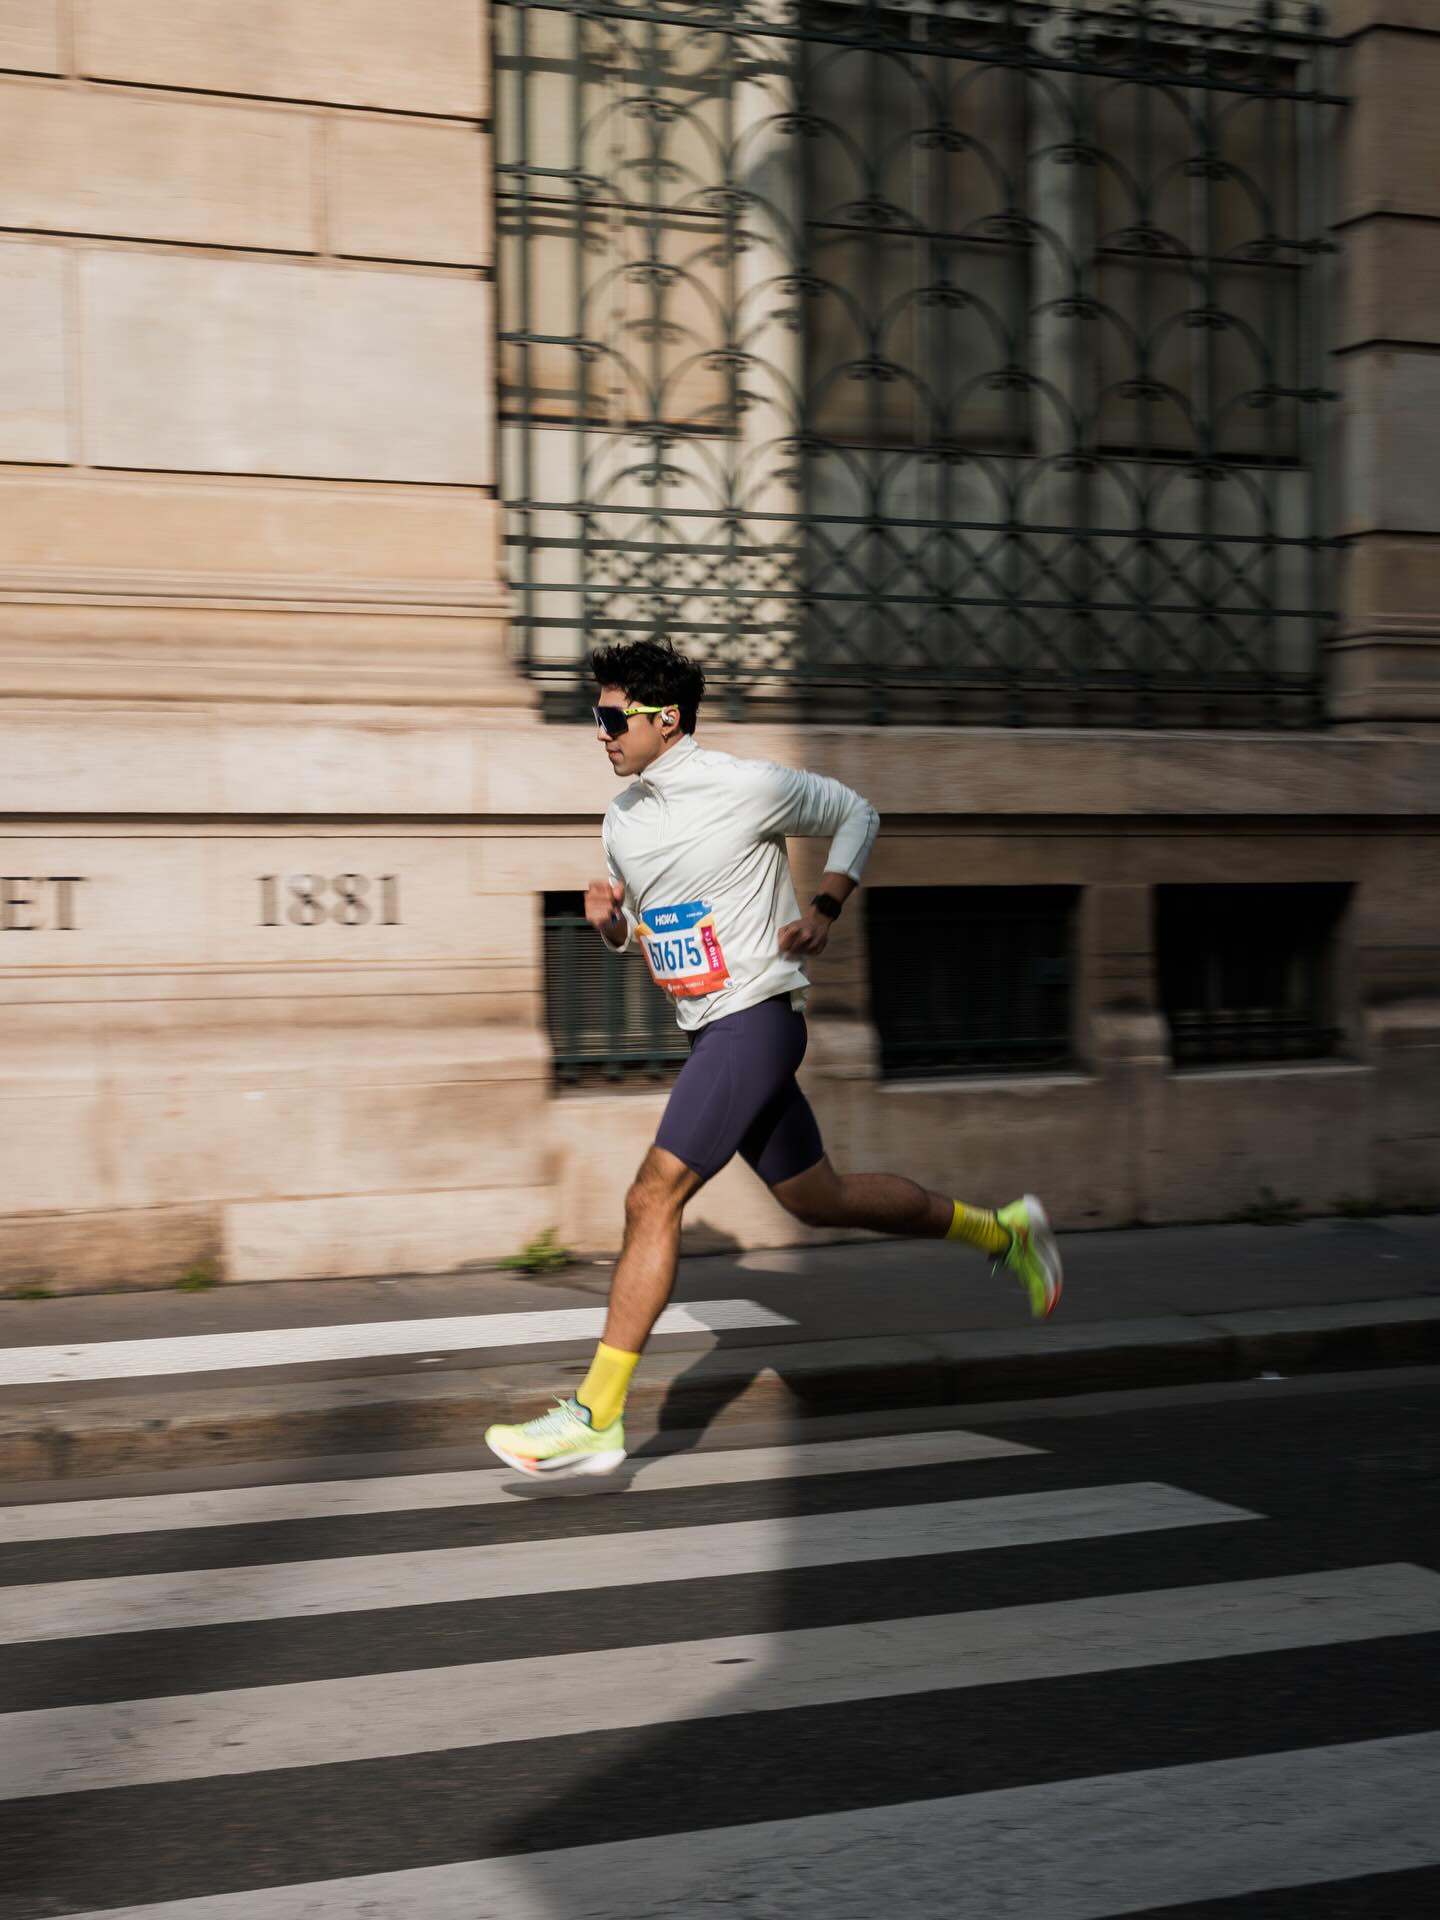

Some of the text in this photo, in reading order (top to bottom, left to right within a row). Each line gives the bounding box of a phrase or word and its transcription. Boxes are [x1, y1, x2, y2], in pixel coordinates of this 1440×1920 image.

[256, 873, 404, 927] 1881
[655, 912, 679, 926] HOKA
[648, 937, 702, 972] 67675
